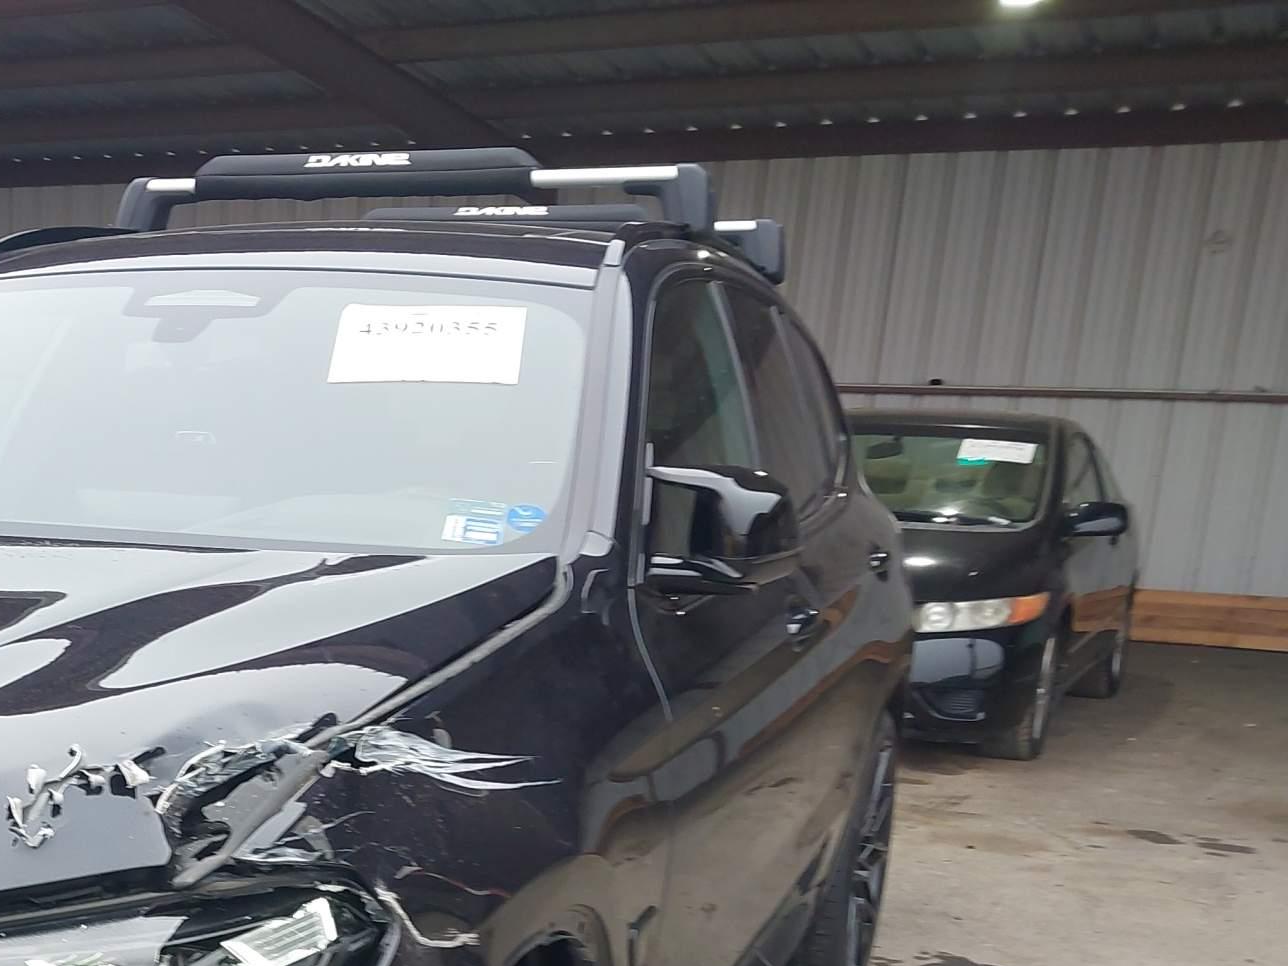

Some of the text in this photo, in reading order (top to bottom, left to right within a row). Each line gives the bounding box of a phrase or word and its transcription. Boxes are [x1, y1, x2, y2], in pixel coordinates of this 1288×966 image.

[304, 152, 412, 168] DAKINE
[453, 206, 549, 216] DAKINE
[359, 320, 498, 336] 43920355
